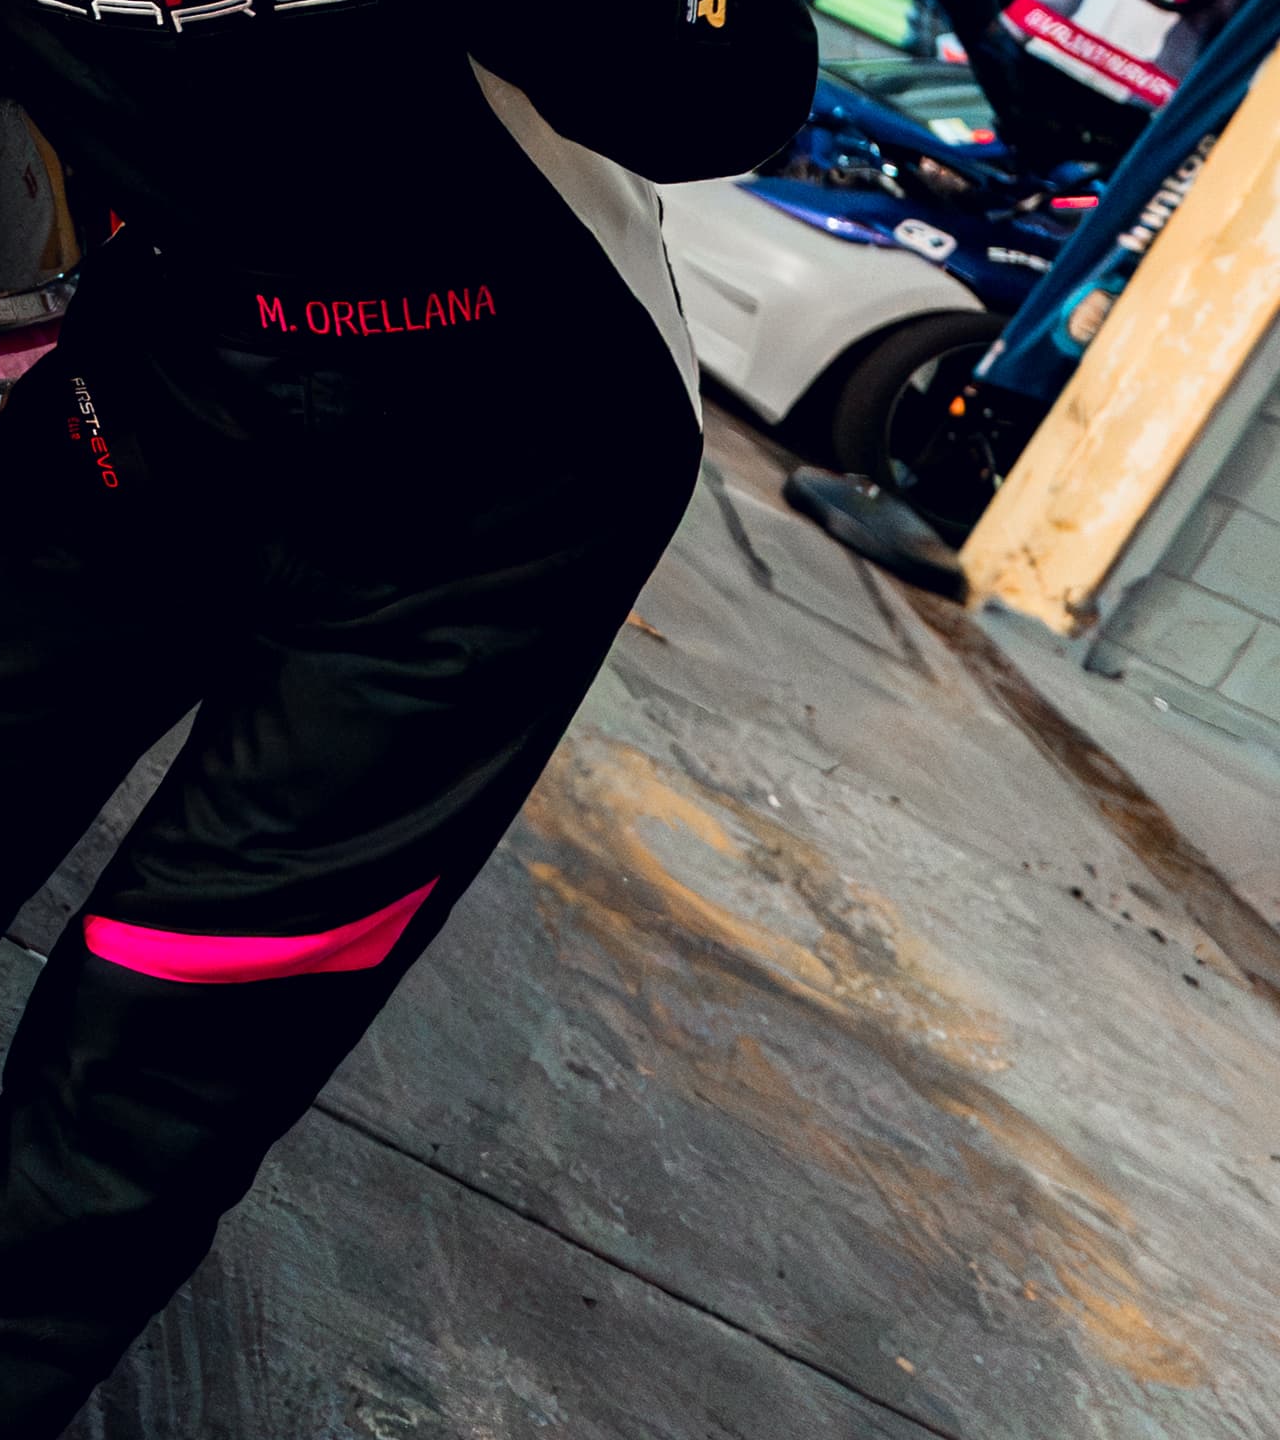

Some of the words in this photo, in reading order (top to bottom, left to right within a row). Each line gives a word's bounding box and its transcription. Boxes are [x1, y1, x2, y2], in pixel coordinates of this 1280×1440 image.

[256, 293, 298, 333] M.
[305, 284, 496, 337] ORELLANA
[71, 377, 119, 489] FIRST-EVO
